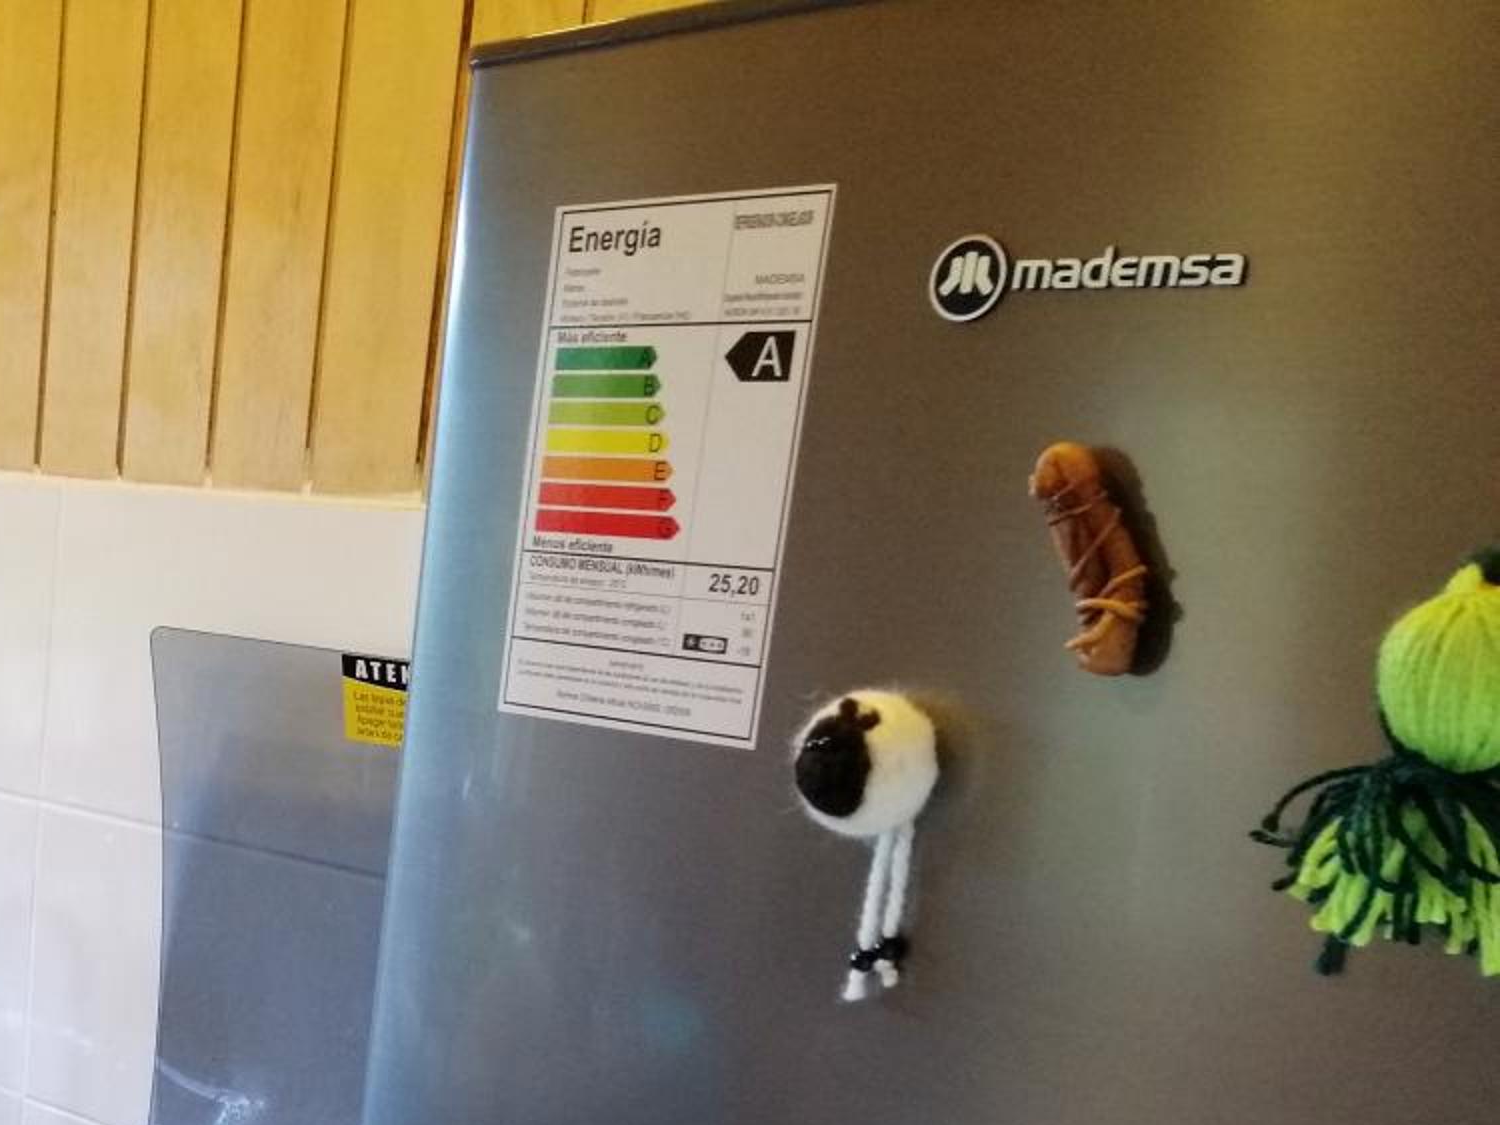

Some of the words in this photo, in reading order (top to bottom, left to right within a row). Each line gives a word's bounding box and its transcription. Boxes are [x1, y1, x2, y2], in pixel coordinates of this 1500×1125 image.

[568, 220, 661, 257] Energía
[1011, 245, 1247, 290] mademsa
[582, 330, 628, 344] eficiente
[751, 335, 783, 378] A
[645, 404, 661, 425] C
[648, 433, 663, 453] D
[654, 461, 667, 481] E
[532, 535, 565, 549] Menos
[568, 539, 613, 553] eficiente
[530, 555, 576, 571] CONSUMO
[578, 559, 623, 575] MENSUAL
[708, 573, 760, 598] 25,20
